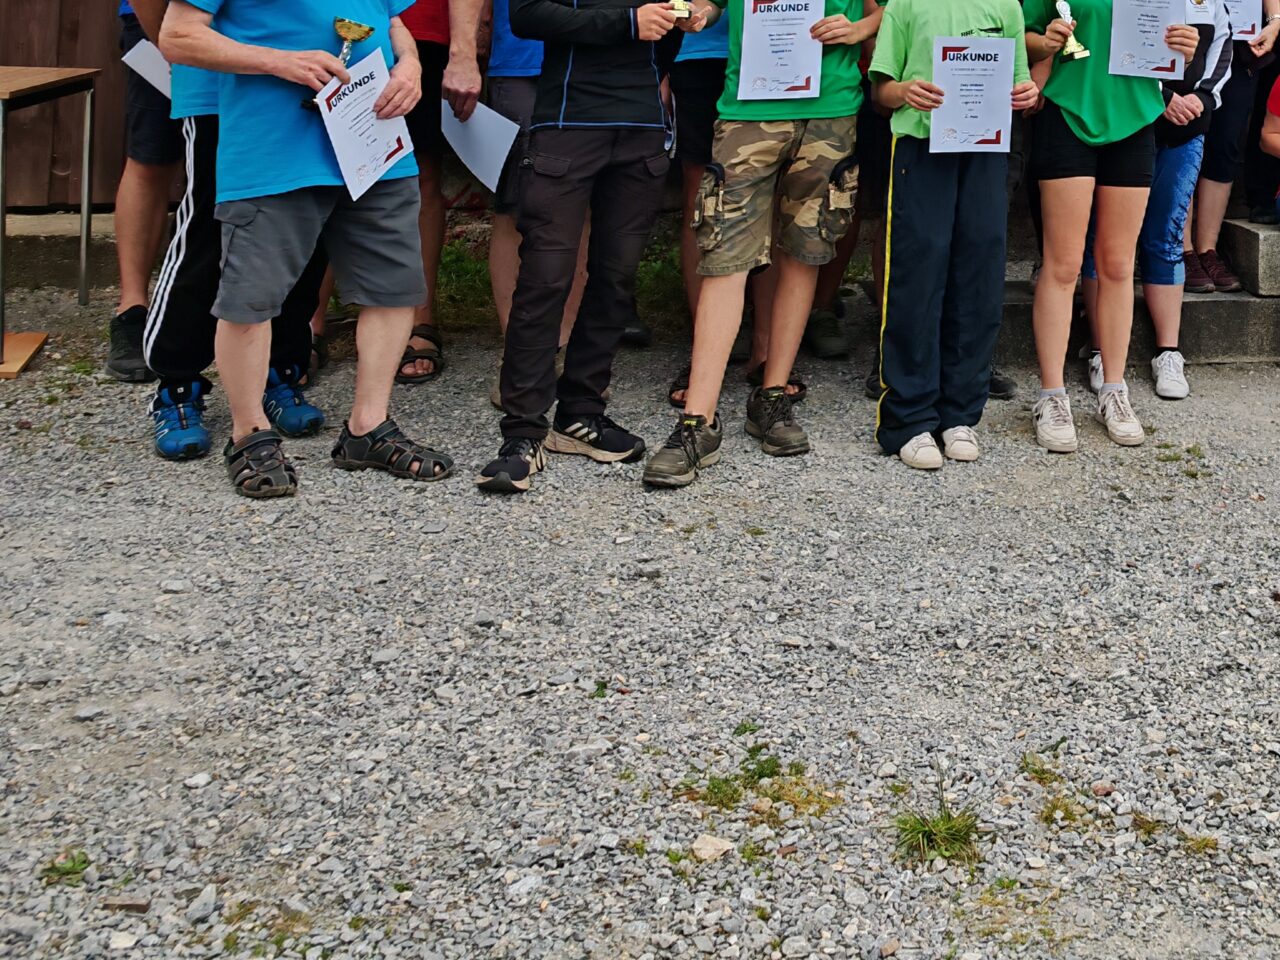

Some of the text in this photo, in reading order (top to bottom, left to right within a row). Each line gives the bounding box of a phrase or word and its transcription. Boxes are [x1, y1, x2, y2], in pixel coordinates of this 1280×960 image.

[758, 3, 810, 13] URKUNDE
[948, 52, 999, 62] URKUNDE
[331, 71, 377, 108] URKUNDE
